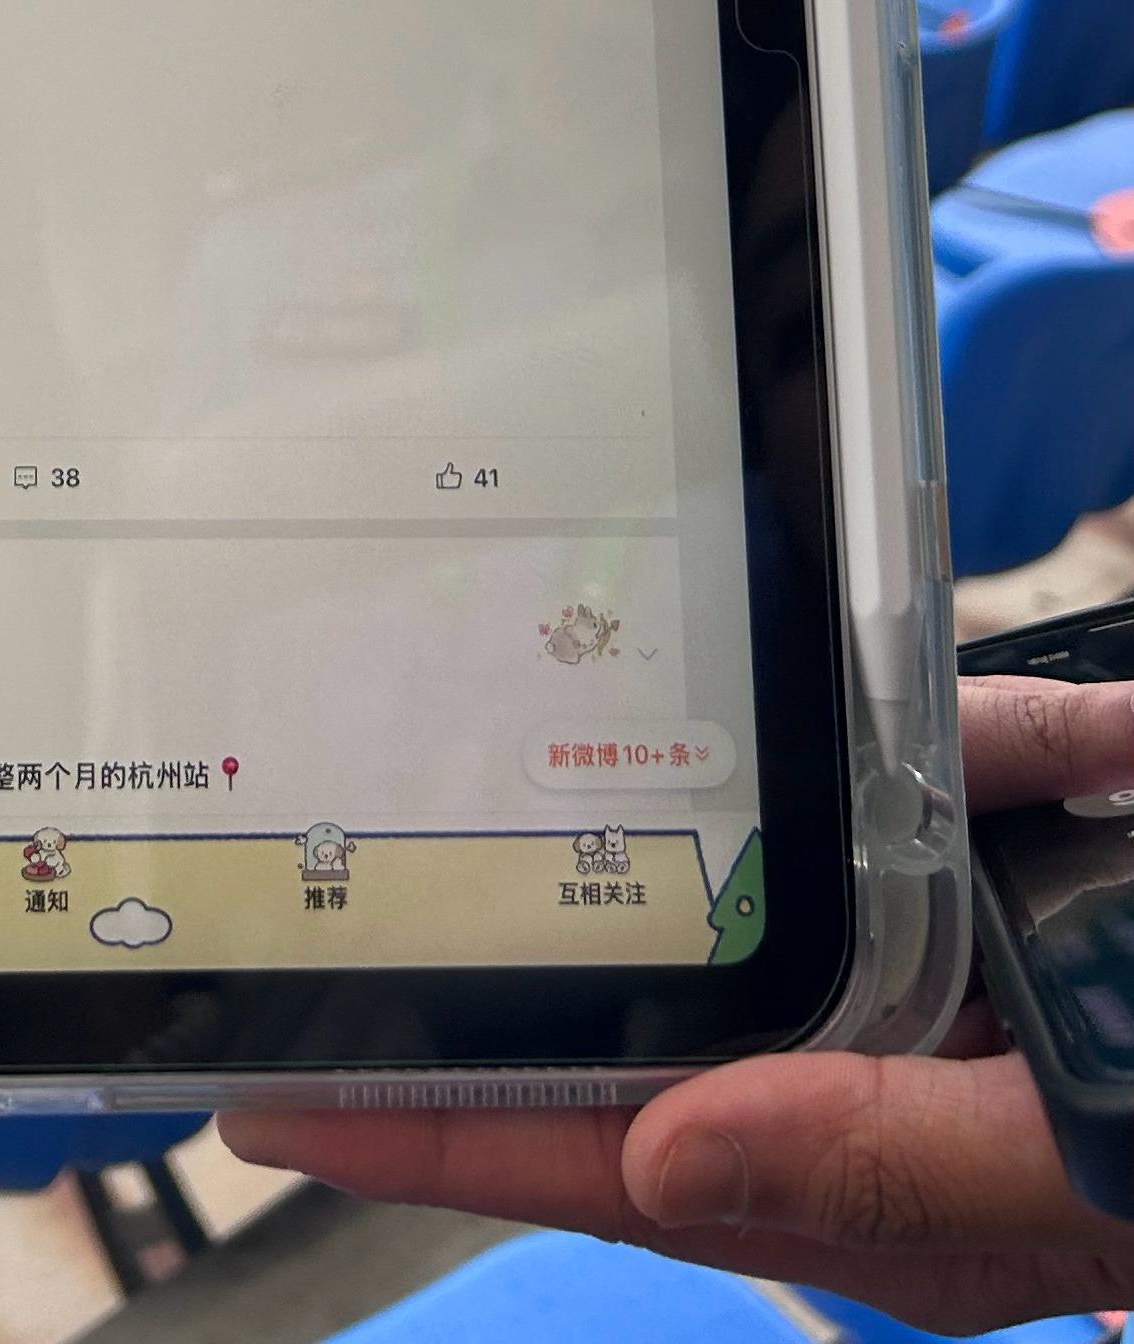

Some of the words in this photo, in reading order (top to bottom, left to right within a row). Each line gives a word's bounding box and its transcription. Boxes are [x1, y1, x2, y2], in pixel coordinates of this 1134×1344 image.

[51, 467, 80, 488] 38
[473, 468, 499, 488] 41
[25, 889, 69, 913] 通知
[304, 885, 348, 910] 推荐
[558, 881, 647, 906] 互相关注
